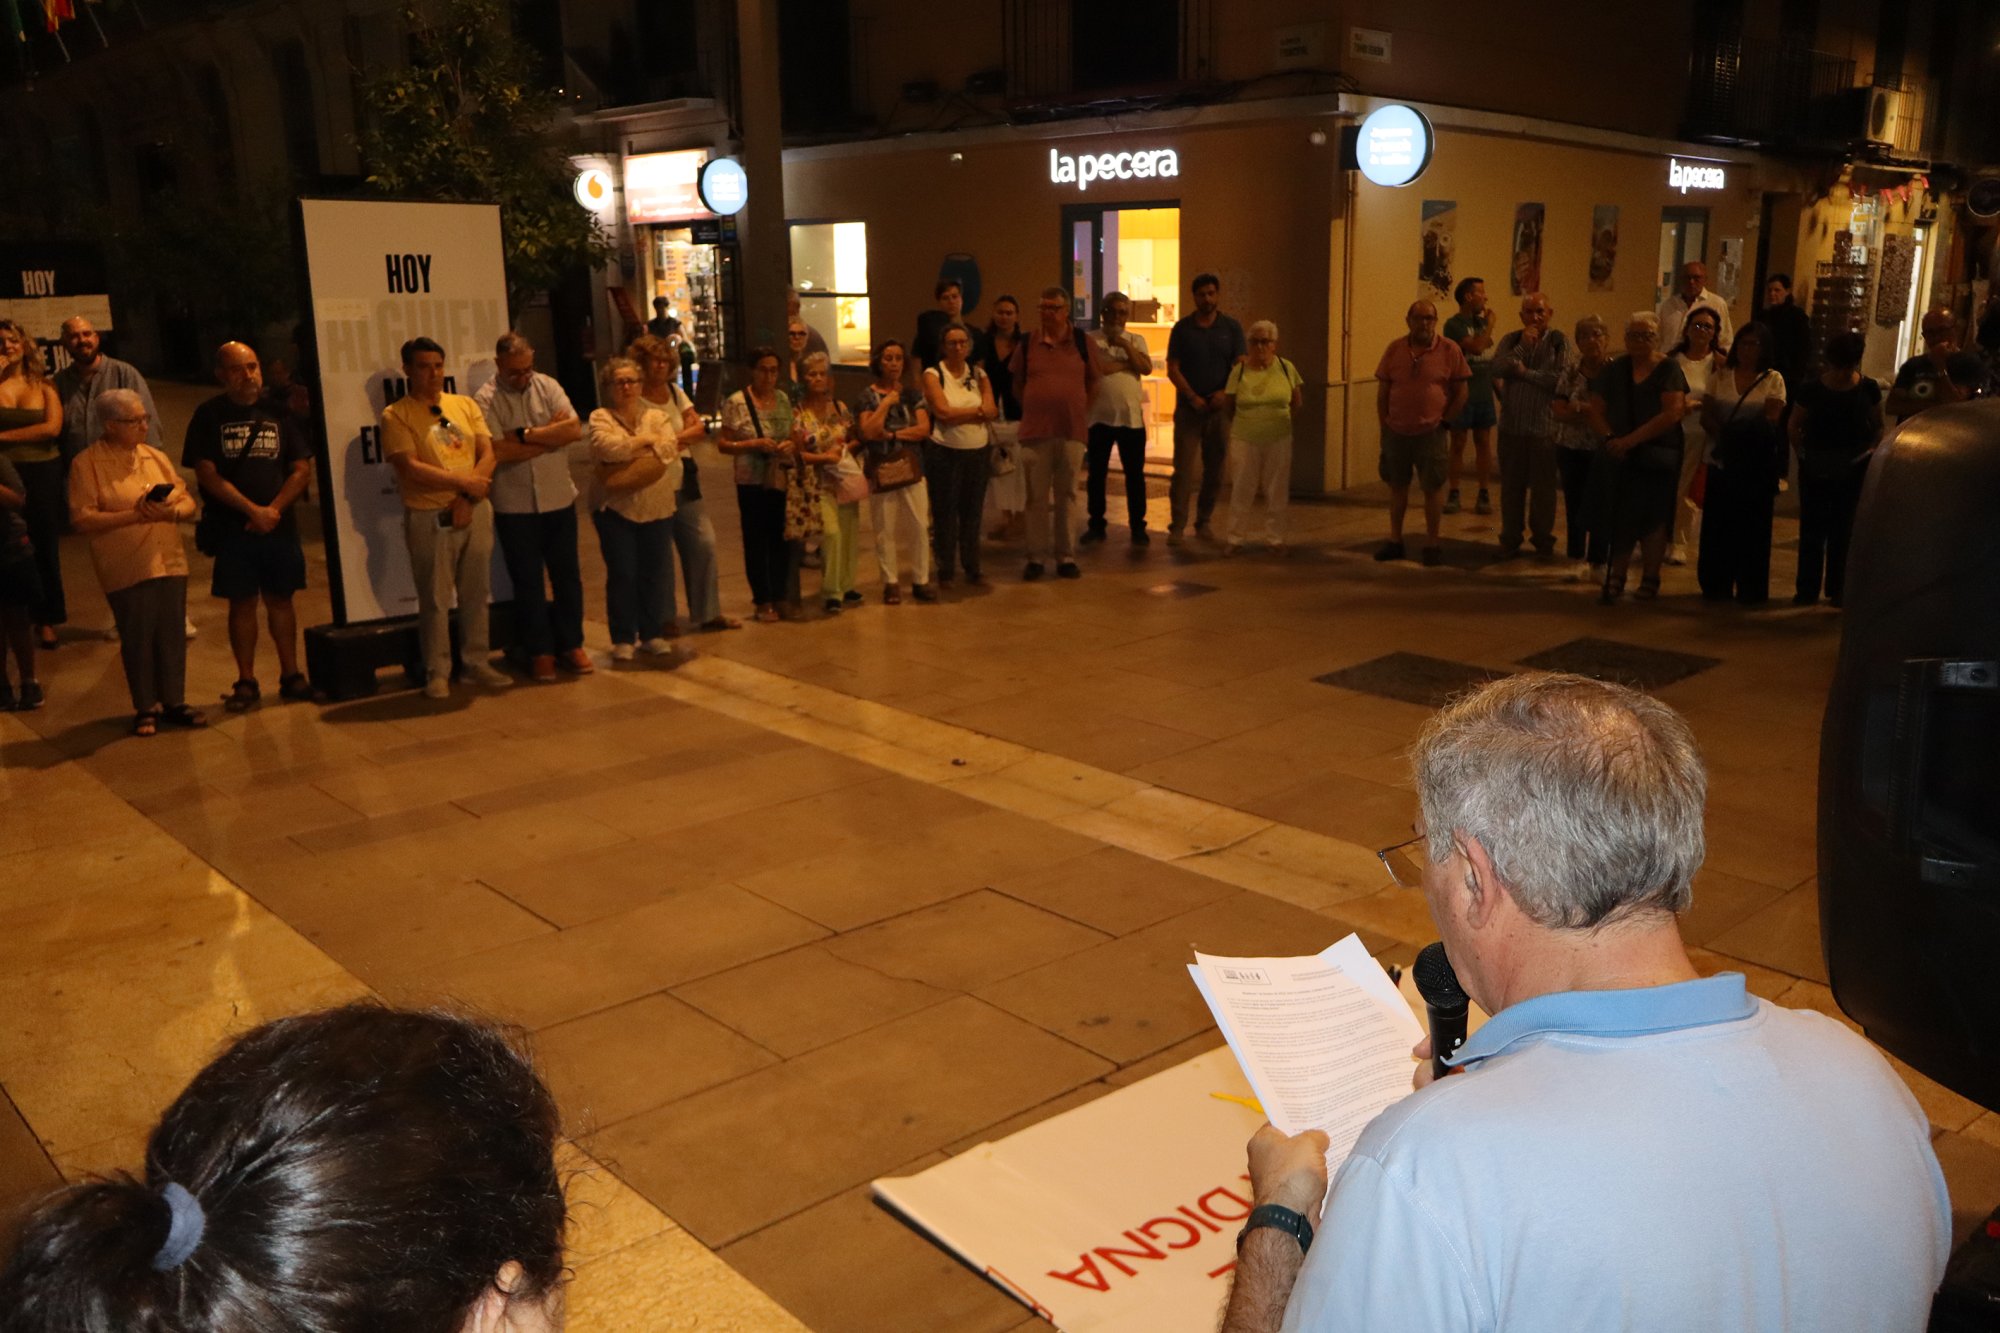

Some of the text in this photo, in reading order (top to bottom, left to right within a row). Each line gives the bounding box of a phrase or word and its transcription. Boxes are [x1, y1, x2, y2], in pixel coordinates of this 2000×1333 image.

[22, 270, 55, 295] HOY
[386, 254, 431, 293] HOY
[1046, 1186, 1255, 1292] DIGNA
